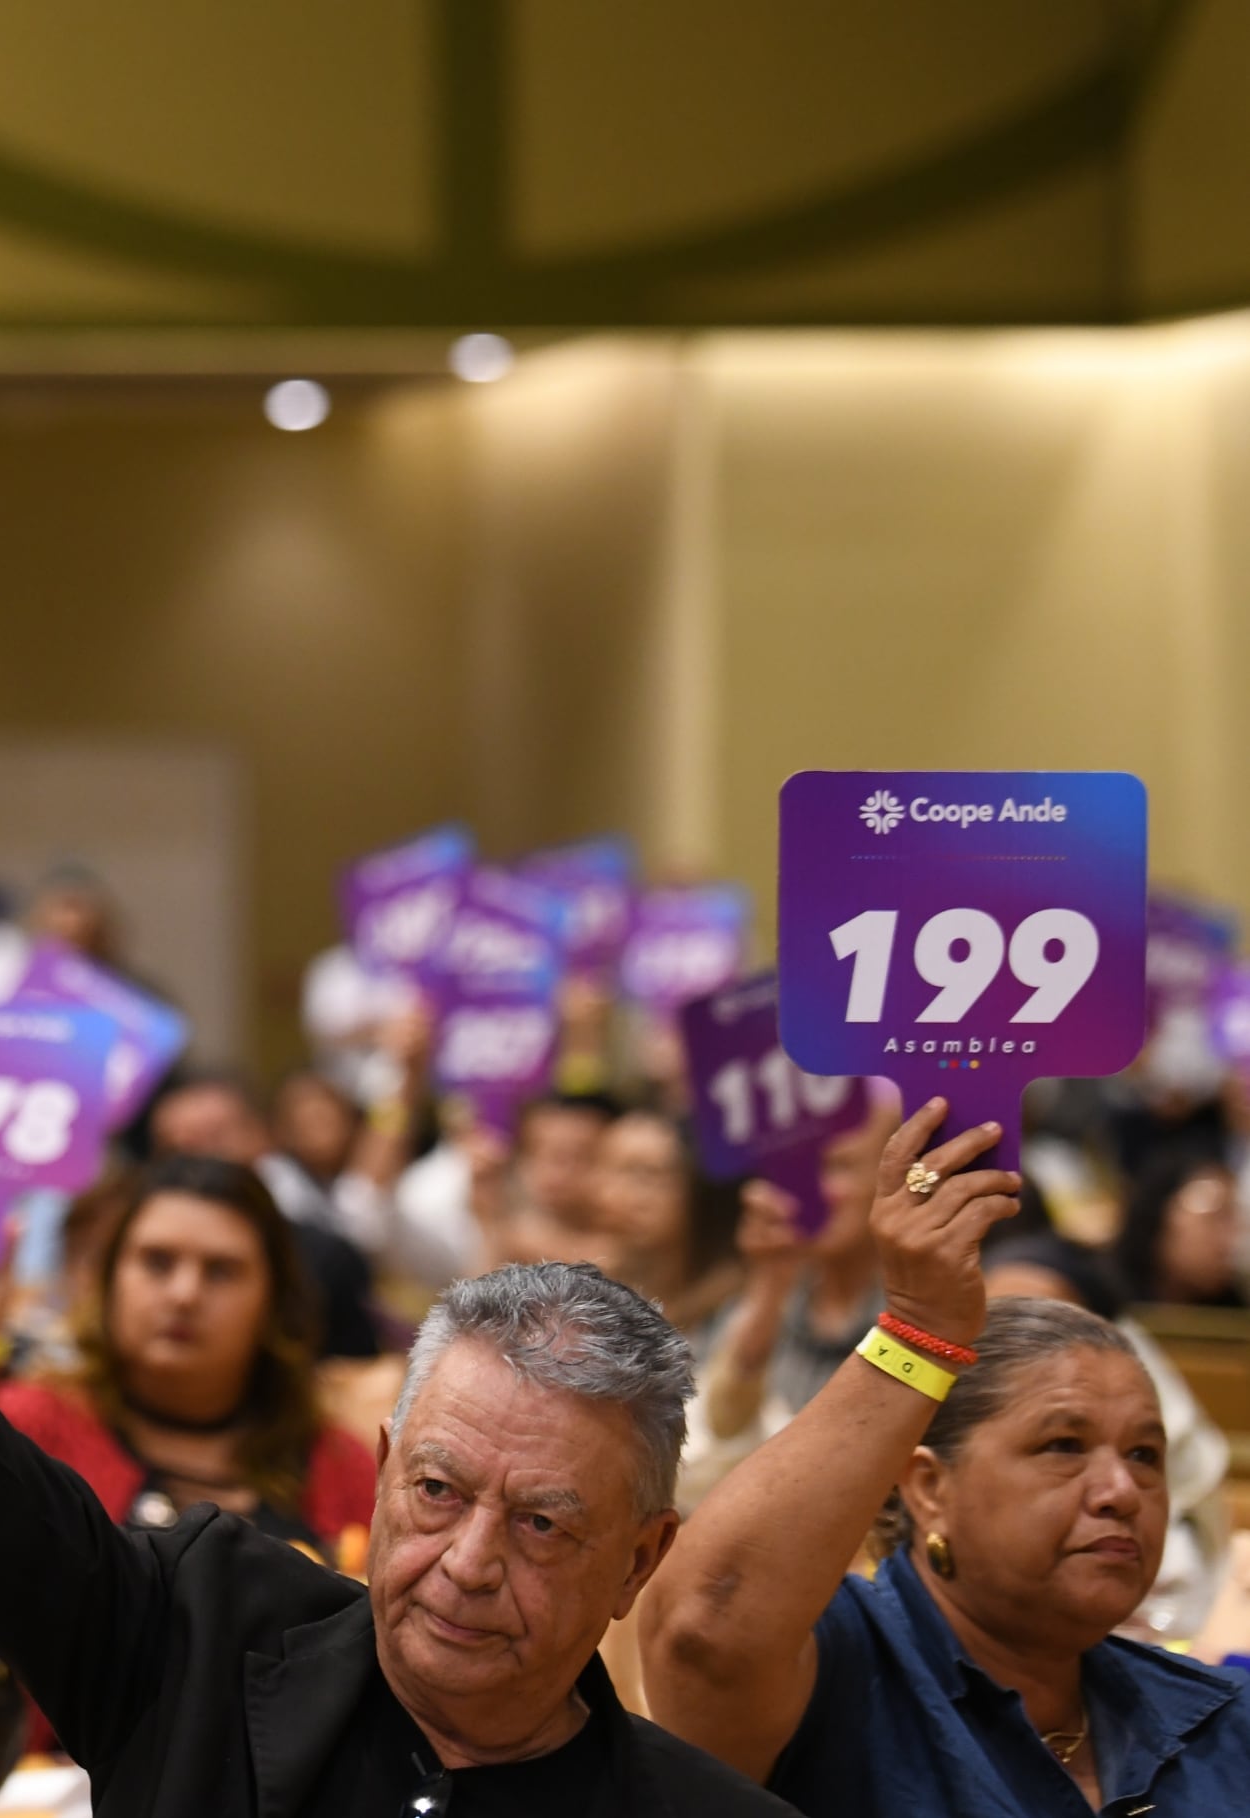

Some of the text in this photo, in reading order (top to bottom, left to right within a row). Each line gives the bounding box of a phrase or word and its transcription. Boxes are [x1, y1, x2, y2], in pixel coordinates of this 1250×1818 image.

[910, 797, 1067, 828] Coope Ande
[828, 908, 1100, 1023] 199
[884, 1036, 1037, 1054] Asamblea
